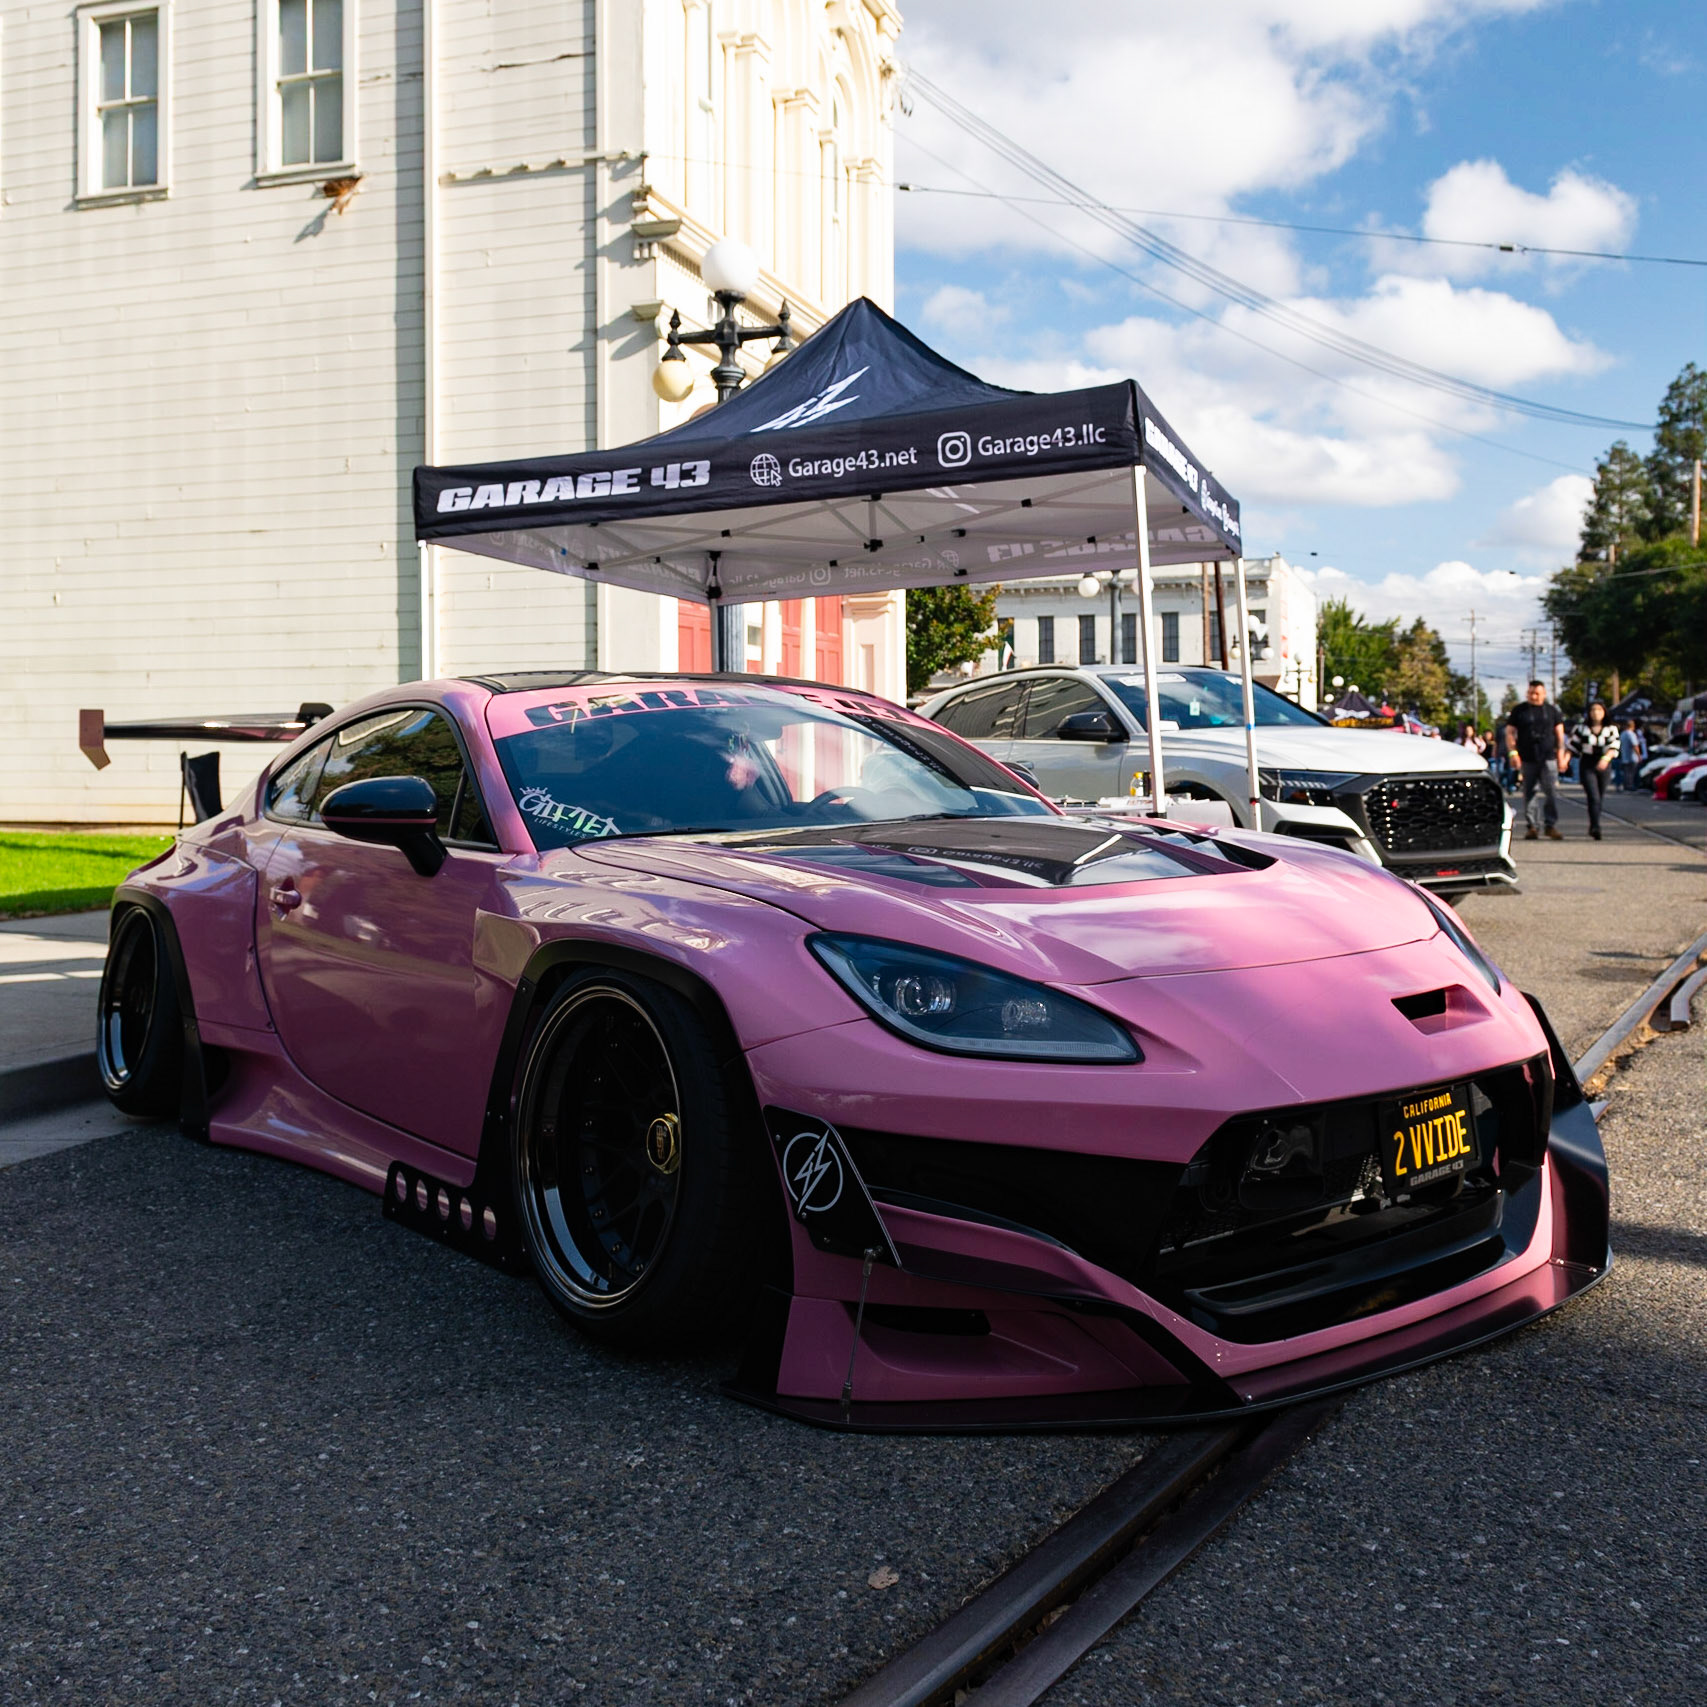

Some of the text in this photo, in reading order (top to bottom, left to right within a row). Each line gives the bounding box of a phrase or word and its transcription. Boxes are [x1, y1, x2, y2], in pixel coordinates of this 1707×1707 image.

[977, 423, 1106, 457] Garage43.llc
[788, 446, 918, 479] Garage43.net
[437, 459, 711, 513] GARAGE 43
[534, 817, 588, 839] LIFESTYLES
[1403, 1092, 1452, 1119] CALIFORNIA
[1393, 1109, 1471, 1176] 2 VVIDE
[1410, 1159, 1465, 1187] GARAGE 43
